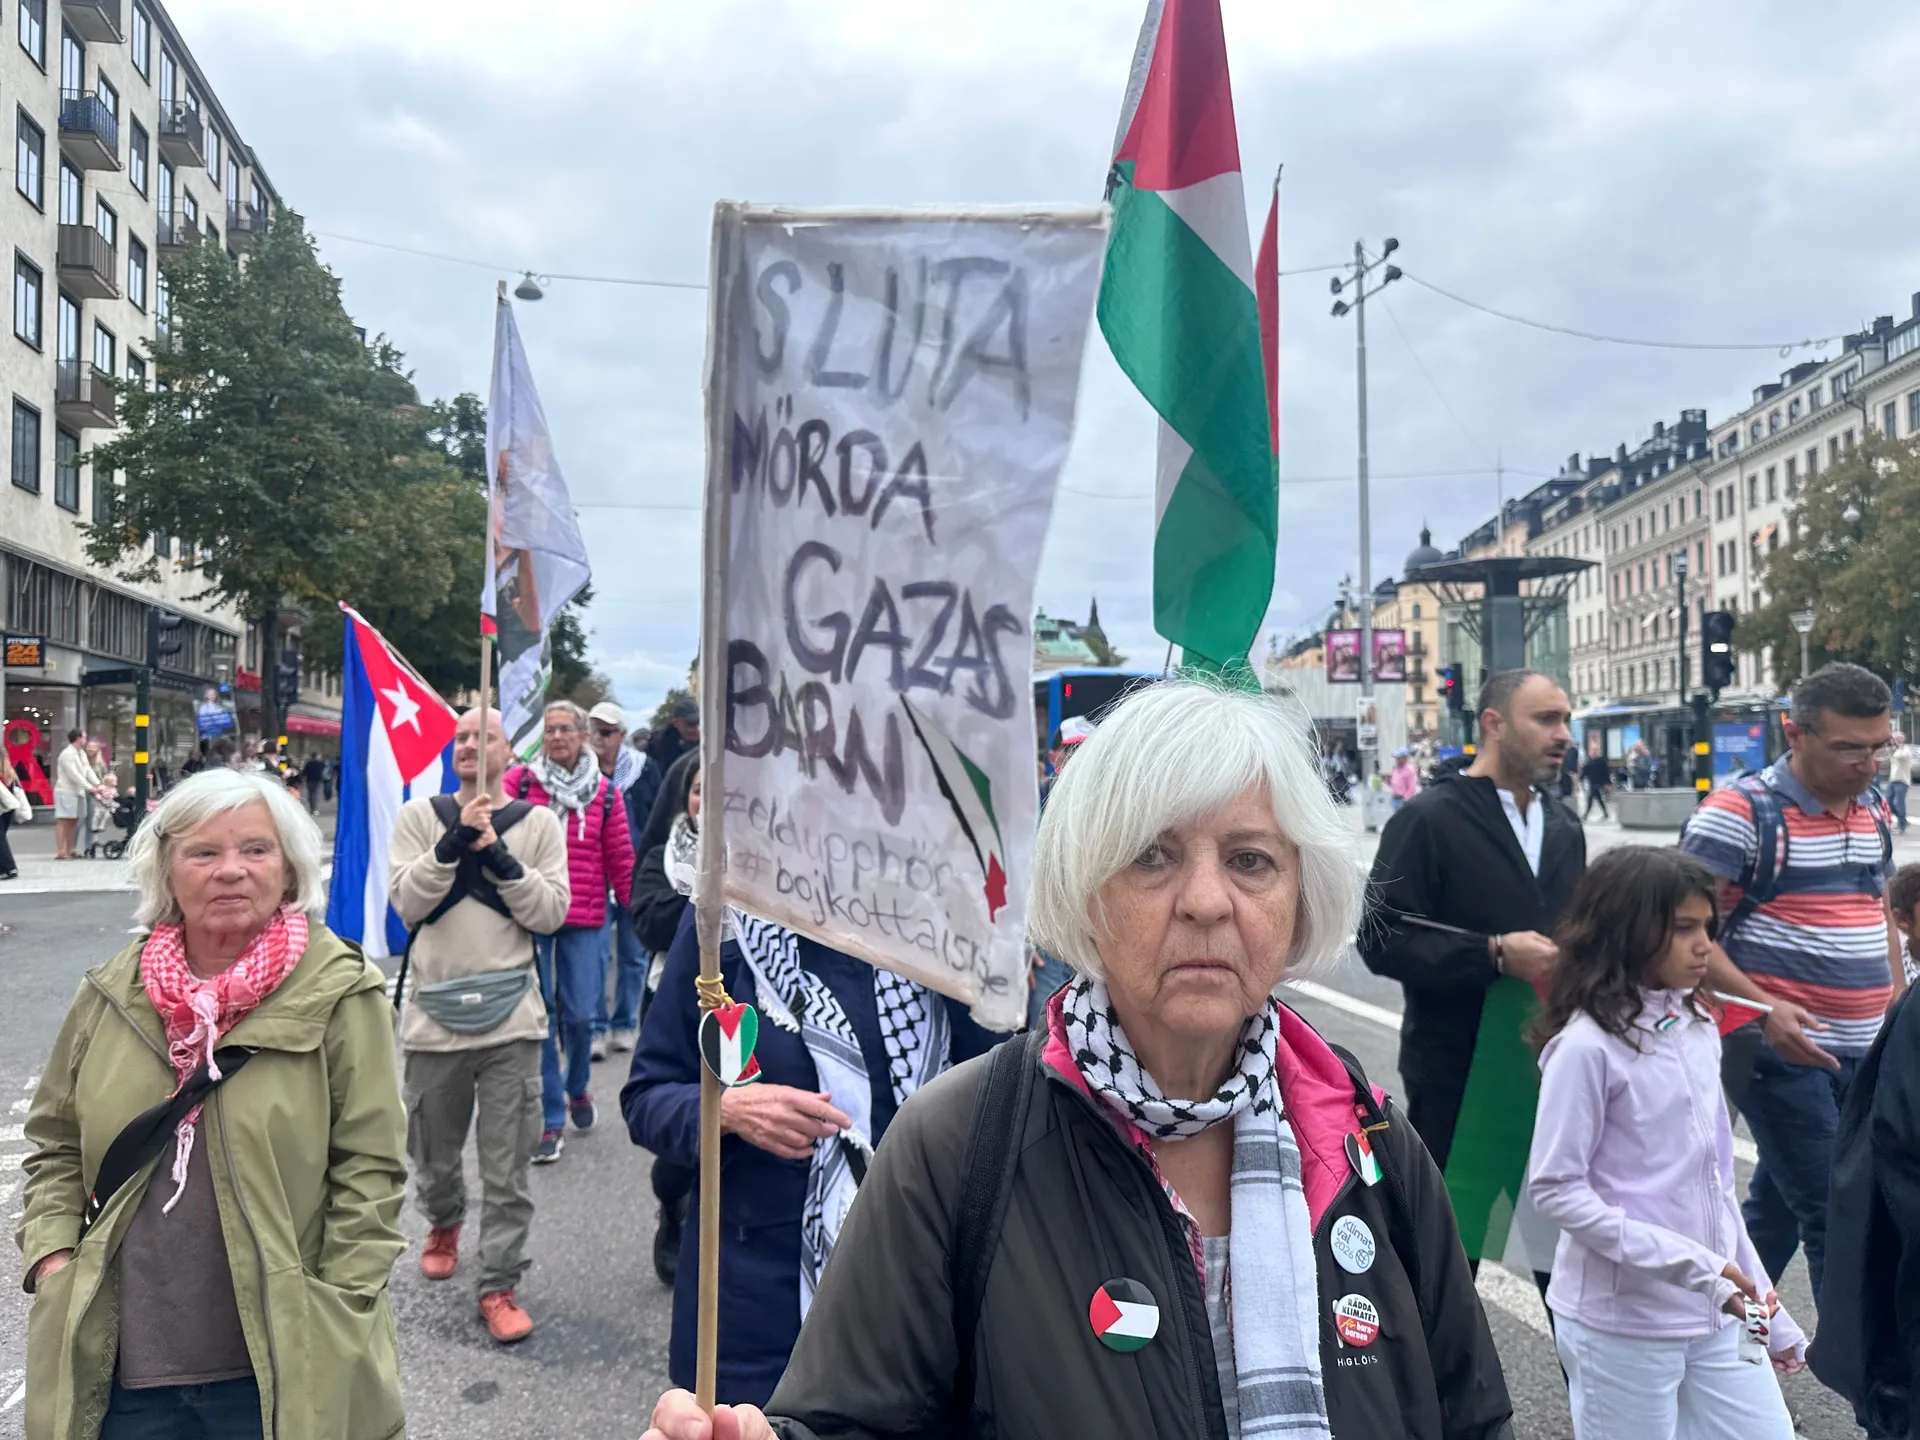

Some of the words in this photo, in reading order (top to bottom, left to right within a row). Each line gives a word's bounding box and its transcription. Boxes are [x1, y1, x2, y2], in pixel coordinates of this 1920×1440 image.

[756, 256, 1031, 424] SLUTA
[731, 394, 937, 547] MÖRDA
[784, 540, 1024, 720] GAZAS
[8, 644, 39, 657] 24
[725, 639, 906, 828] BARN
[1336, 1227, 1352, 1245] val
[1343, 1218, 1373, 1250] Klimat
[1333, 1237, 1354, 1260] 2026
[1341, 1305, 1376, 1323] KLIMATET
[1347, 1297, 1373, 1313] RÄDDA
